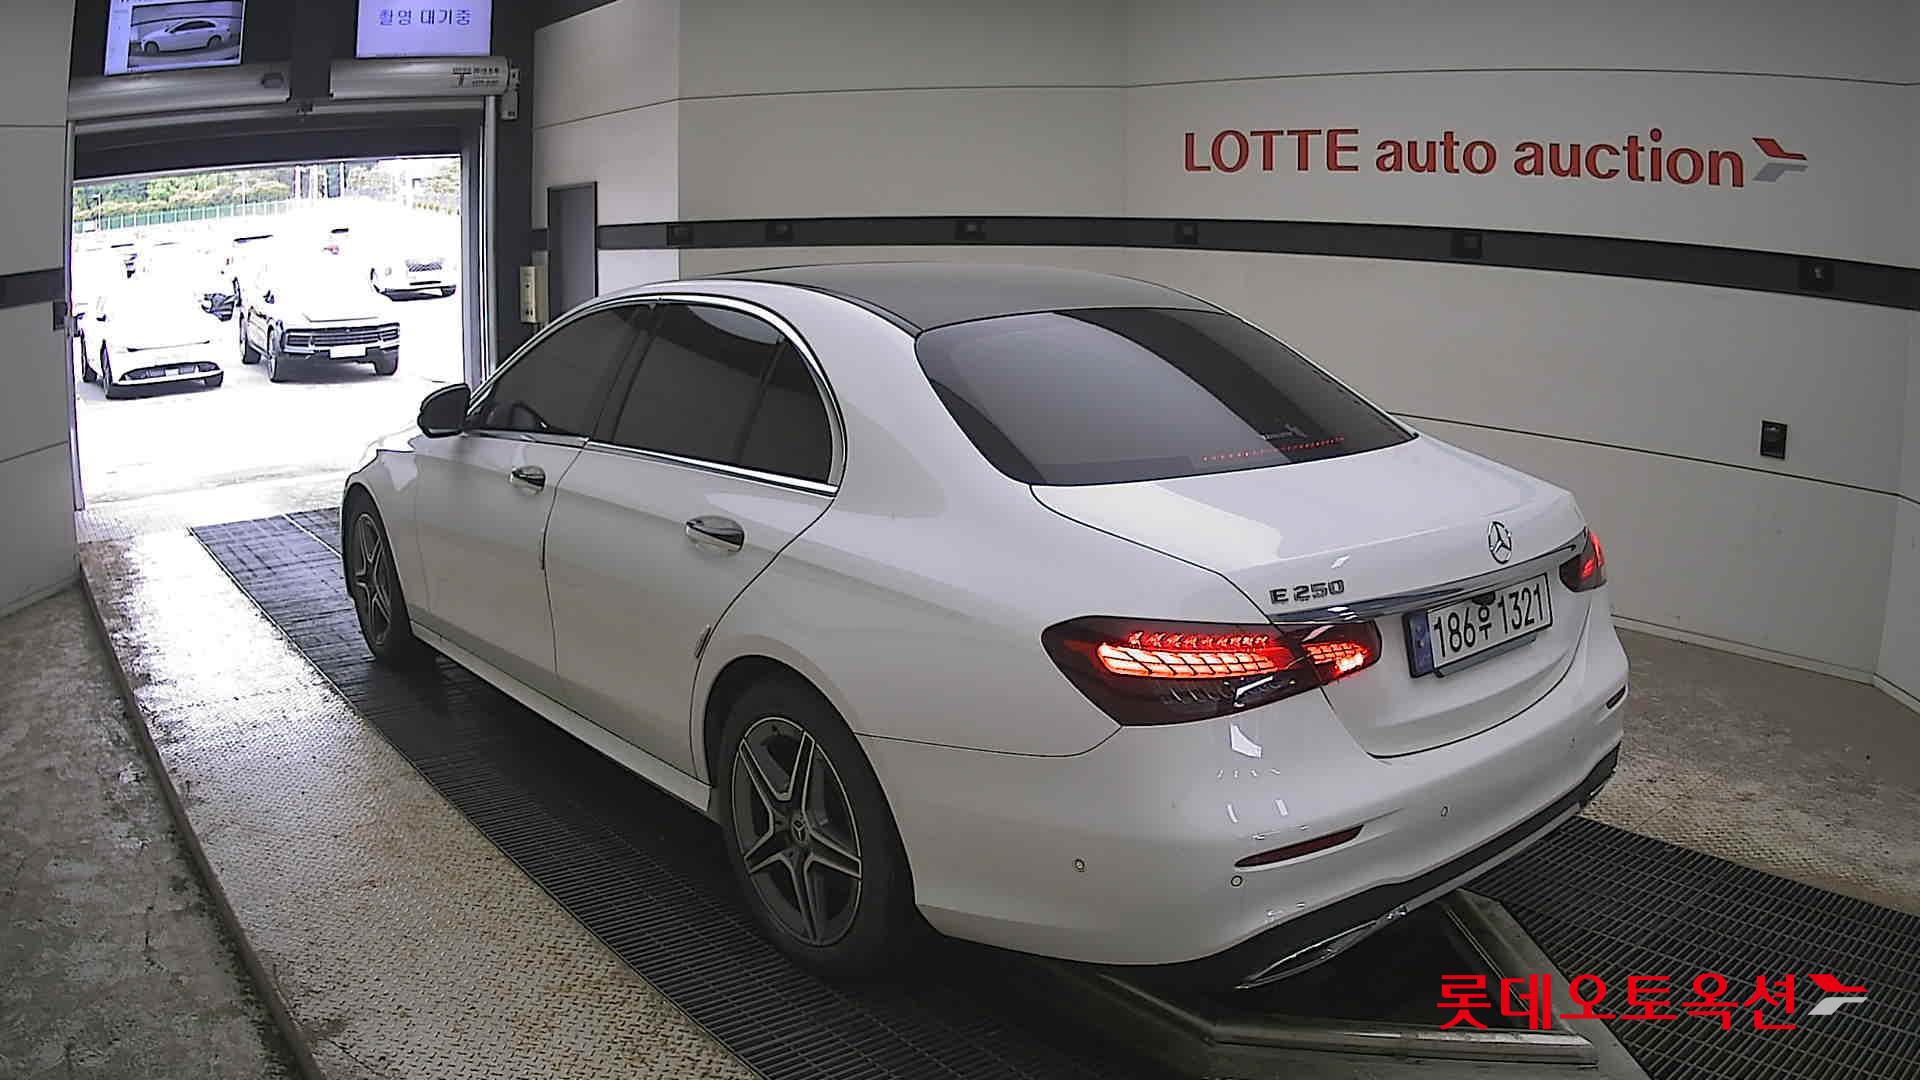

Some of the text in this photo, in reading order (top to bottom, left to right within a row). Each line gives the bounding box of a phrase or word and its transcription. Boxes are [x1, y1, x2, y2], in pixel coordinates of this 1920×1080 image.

[420, 8, 472, 26] 대기중
[1184, 127, 1745, 188] LOTTE auto auction
[1269, 578, 1345, 605] E 250
[1498, 582, 1544, 635] 1321
